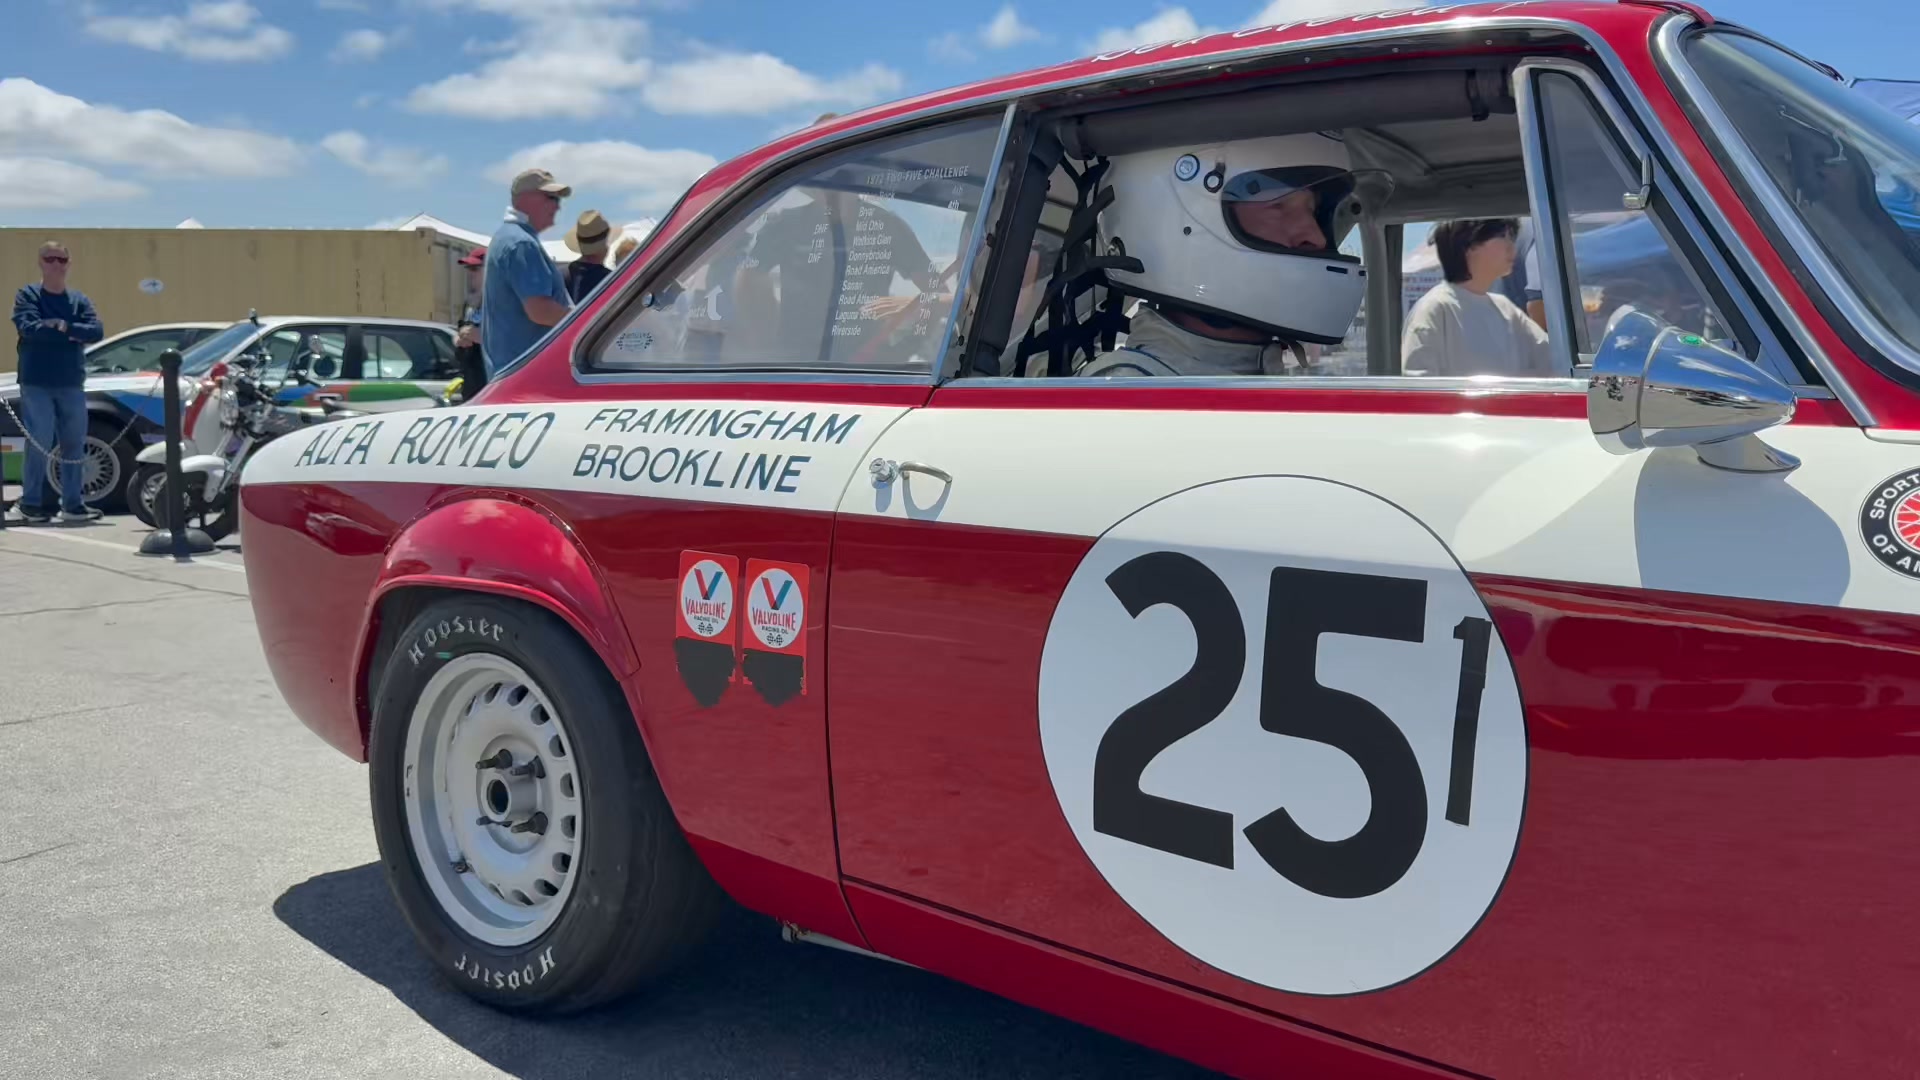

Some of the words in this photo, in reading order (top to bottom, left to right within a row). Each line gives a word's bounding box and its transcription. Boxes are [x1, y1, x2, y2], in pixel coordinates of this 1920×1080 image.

[923, 165, 969, 180] CHALLENGE
[856, 220, 868, 231] Mid
[869, 219, 884, 231] Ohio
[877, 234, 892, 246] Glen
[807, 252, 823, 264] DNF
[848, 249, 892, 264] Donnybrooke
[845, 266, 862, 277] Road
[863, 264, 890, 275] America
[928, 277, 939, 289] 1st
[838, 295, 856, 305] Road
[835, 309, 859, 324] Laguna
[919, 308, 931, 320] 7th
[831, 324, 862, 336] Riverside
[914, 324, 927, 336] 3rd
[584, 407, 862, 445] FRAMINGHAM
[294, 420, 385, 467] ALFA
[388, 411, 556, 469] ROMEO
[572, 443, 812, 493] BROOKLINE
[1872, 534, 1898, 554] OF
[685, 597, 726, 620] VALVOLINE
[752, 607, 796, 631] VALVOLINE
[761, 625, 780, 633] RACING
